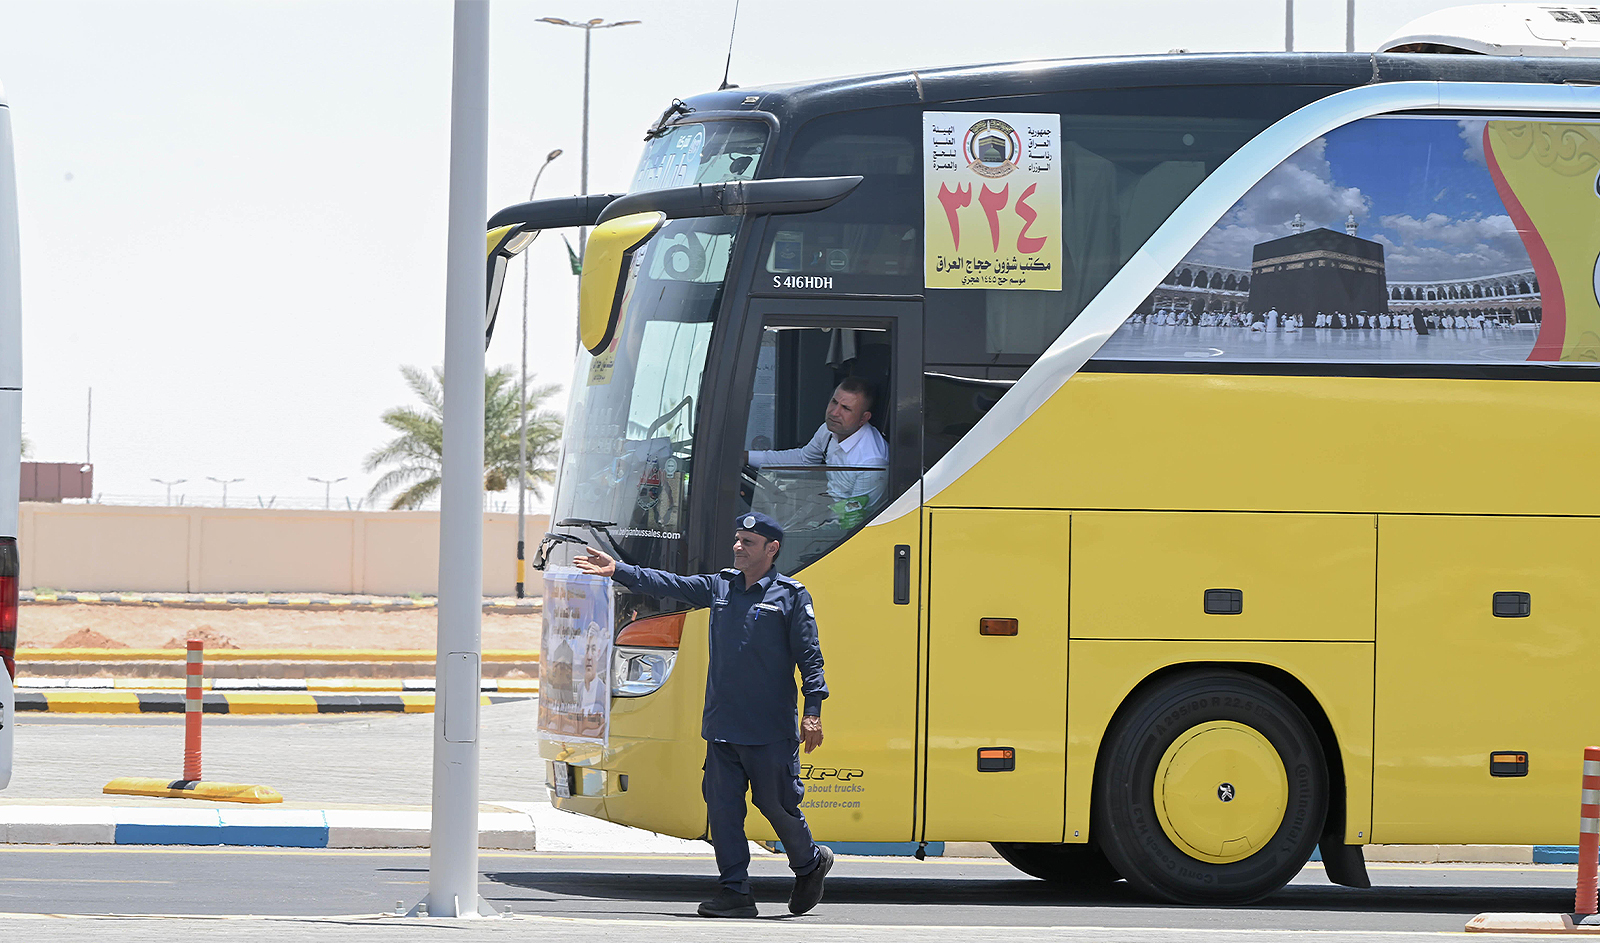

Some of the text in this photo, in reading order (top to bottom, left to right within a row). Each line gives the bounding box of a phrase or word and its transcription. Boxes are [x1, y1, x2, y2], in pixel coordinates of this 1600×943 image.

[1027, 126, 1052, 138] جمهورية
[932, 137, 956, 148] العليا
[1027, 139, 1051, 149] العراق
[932, 149, 957, 160] للحج
[1028, 150, 1053, 161] رئاسة
[932, 160, 958, 172] والعمرة
[1028, 163, 1051, 173] الوزراء
[937, 181, 1048, 255] ٣٢٤
[936, 255, 1051, 275] مكتب شؤون حجاج العراق
[773, 275, 781, 288] S
[961, 275, 1026, 286] موسم حج ١٤٤٥ هجري
[1164, 698, 1208, 725] 295/80
[1212, 696, 1221, 707] R
[1224, 696, 1254, 712] 22.5
[807, 784, 832, 793] about
[800, 799, 861, 808] uckstore.com
[1295, 763, 1313, 844] Continental
[1142, 832, 1176, 870] Coach
[1177, 867, 1214, 885] Conti
